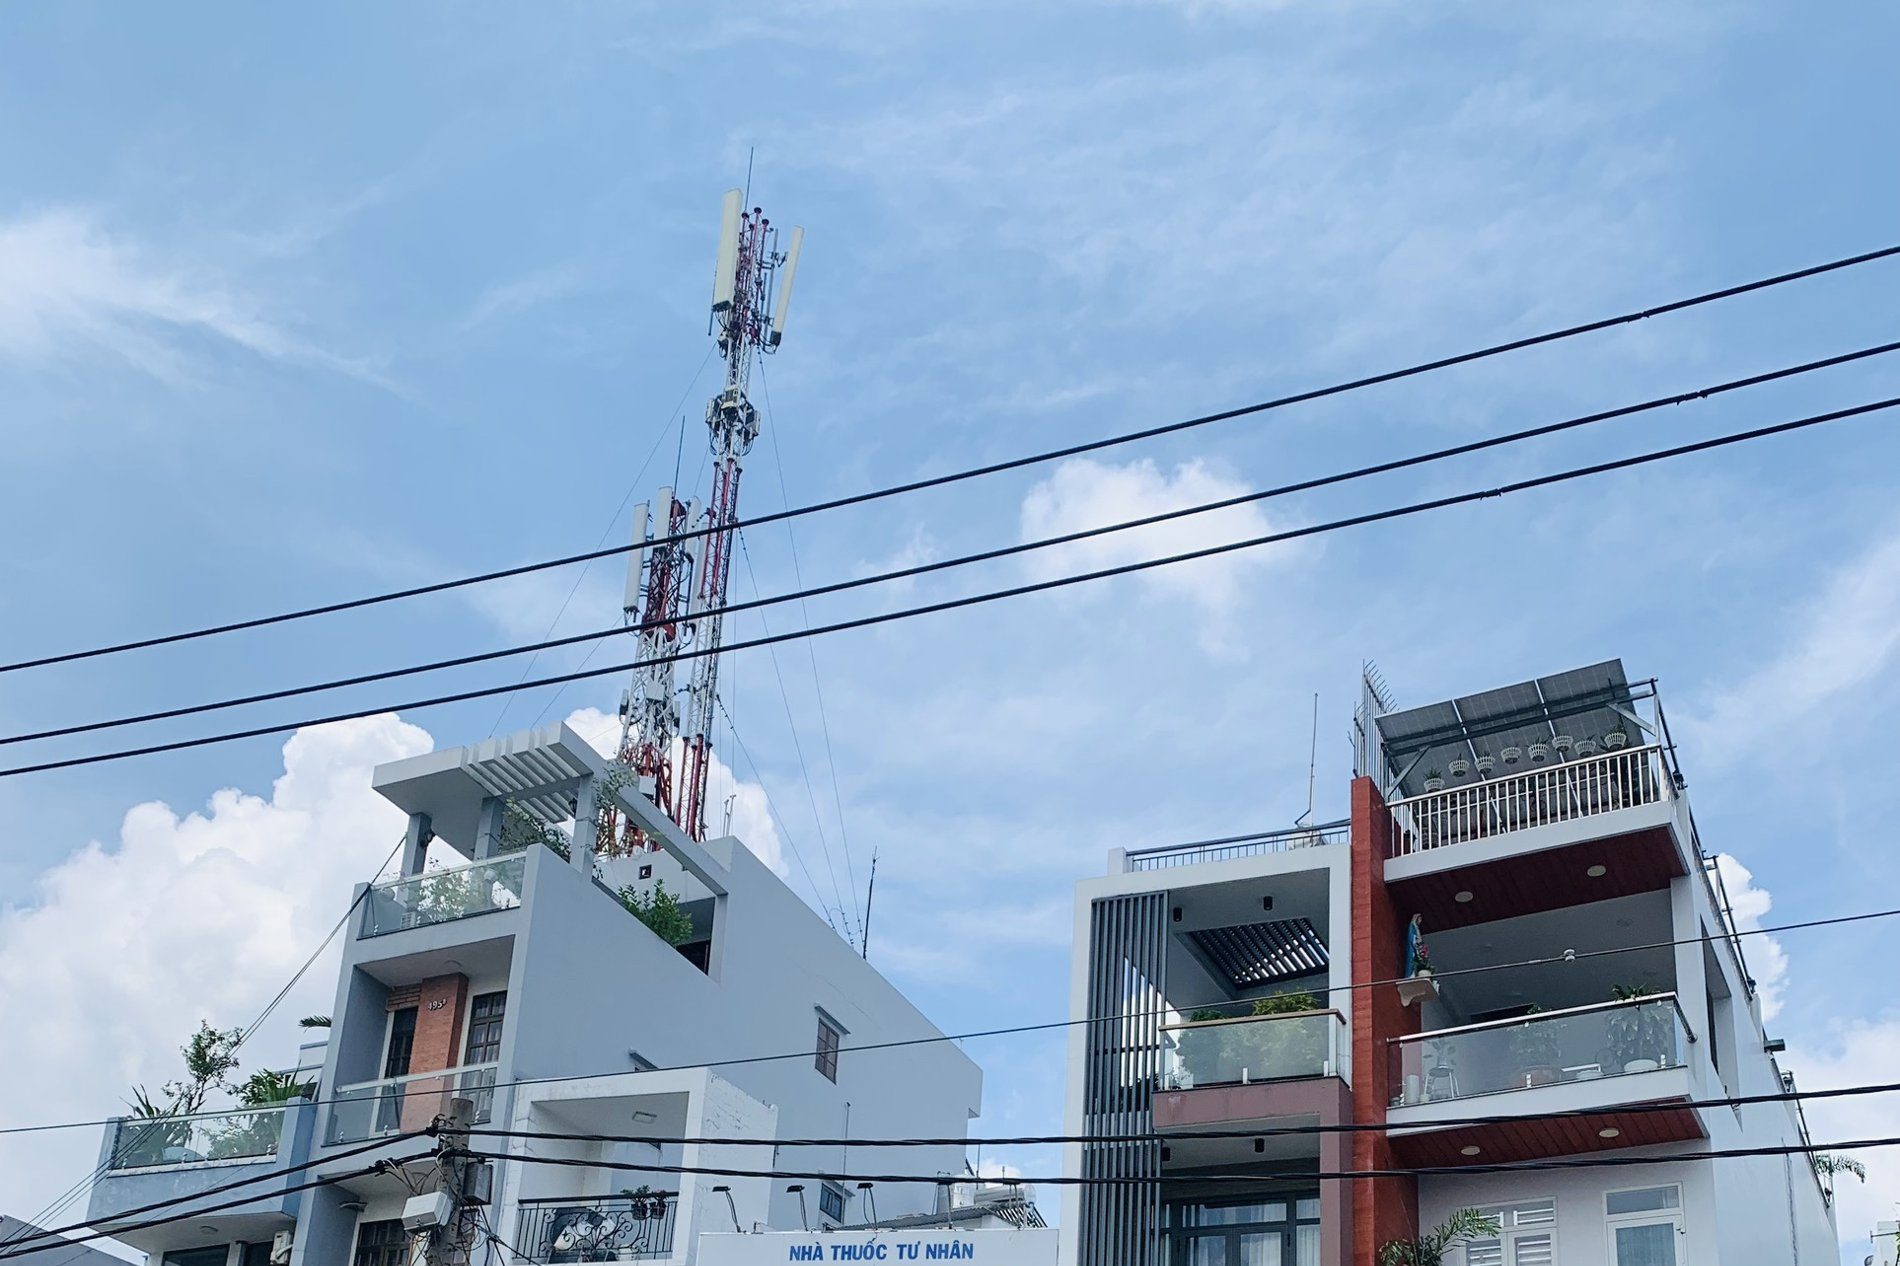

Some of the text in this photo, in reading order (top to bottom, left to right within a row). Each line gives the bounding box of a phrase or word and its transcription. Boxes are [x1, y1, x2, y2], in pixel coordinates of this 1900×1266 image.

[789, 1240, 974, 1261] NHÀ THUỐC TƯ NHÂN
